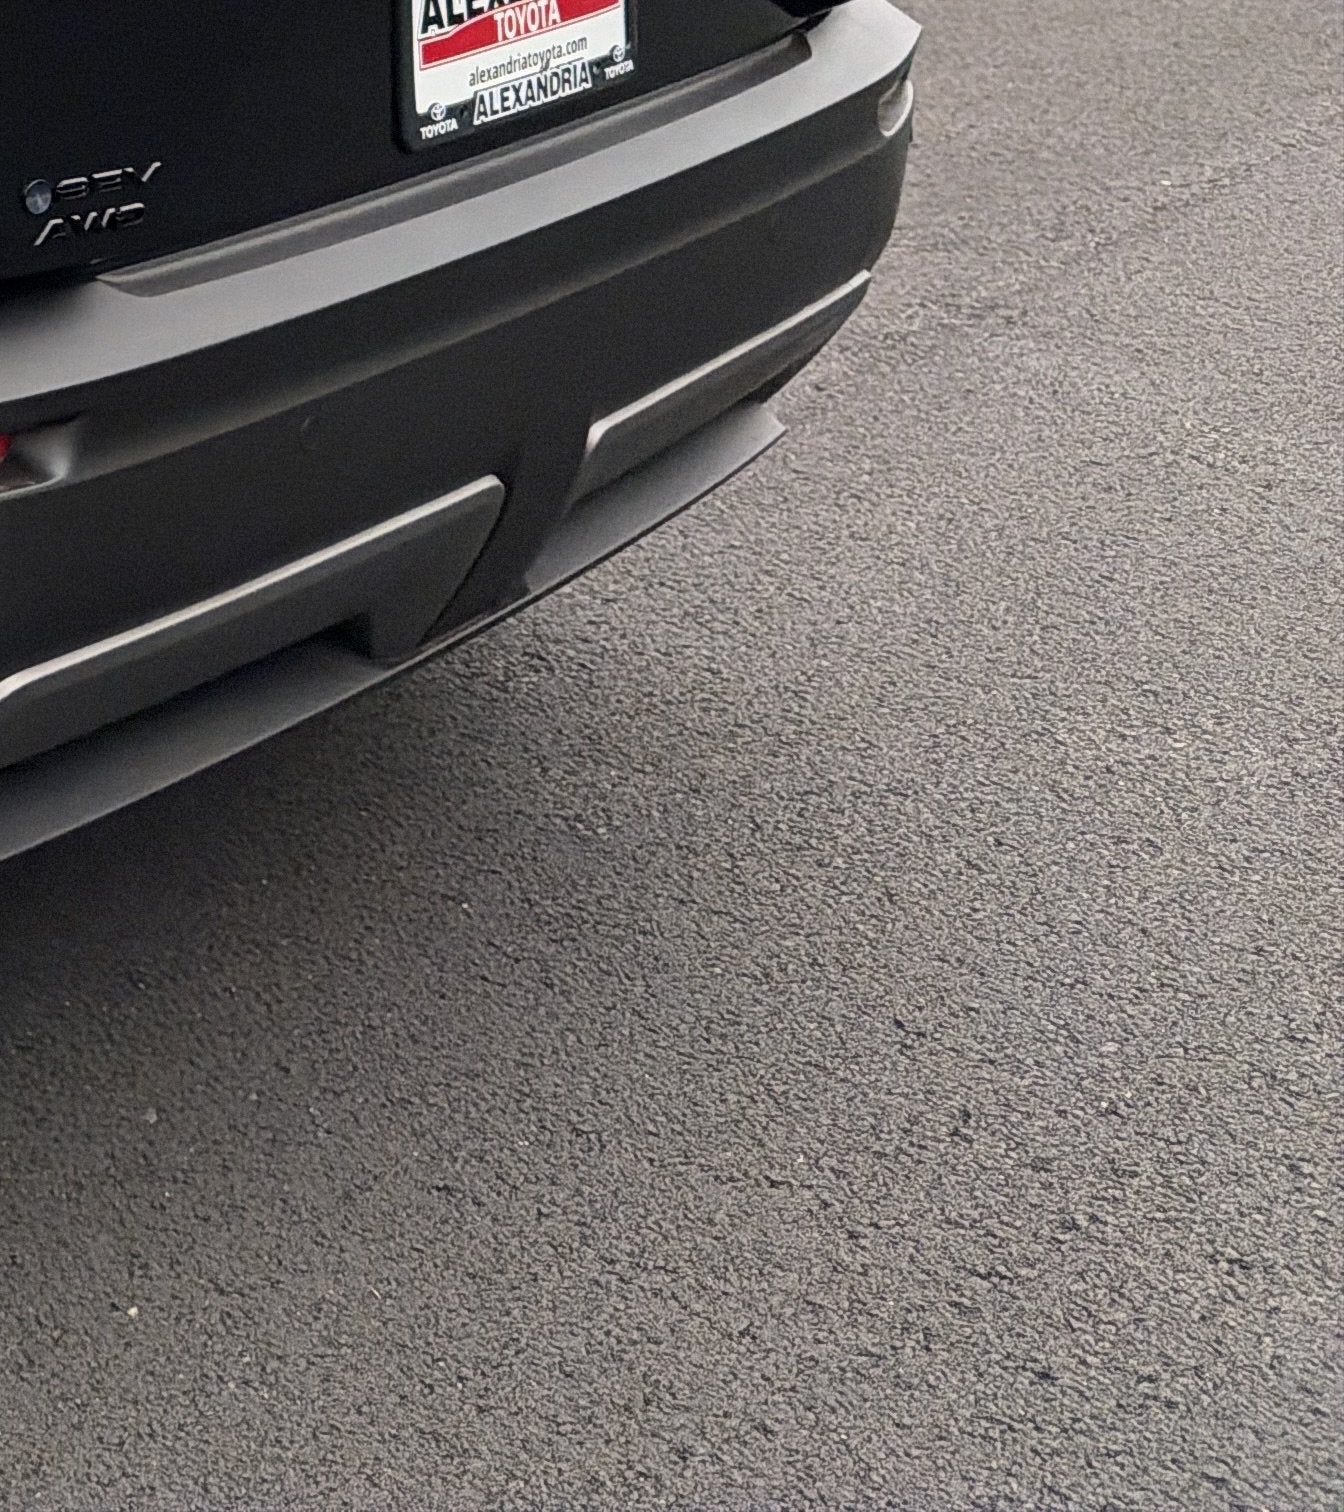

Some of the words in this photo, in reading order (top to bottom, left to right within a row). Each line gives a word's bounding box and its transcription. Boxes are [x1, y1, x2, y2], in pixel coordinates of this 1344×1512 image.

[468, 37, 588, 87] alexandriatoyota.com
[603, 59, 634, 81] TOYOTA
[475, 61, 590, 123] ALEXANDRIA
[419, 117, 459, 141] TOYOTA
